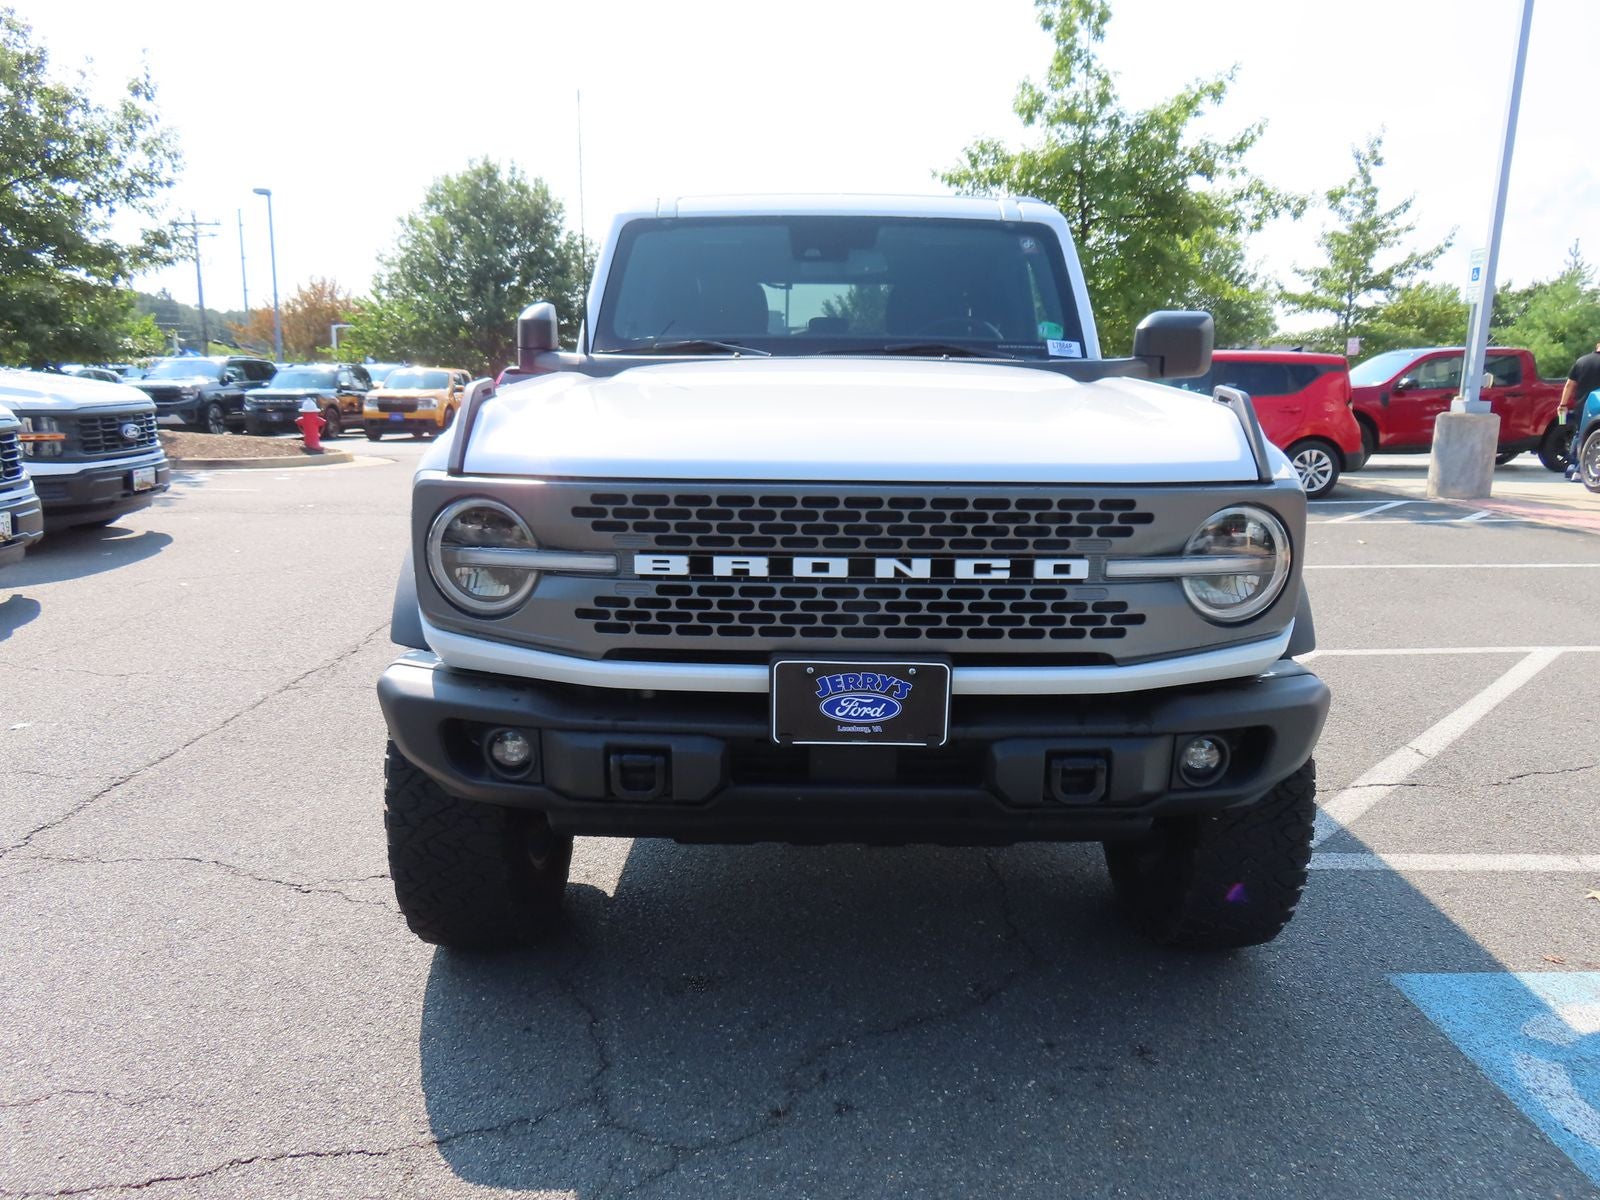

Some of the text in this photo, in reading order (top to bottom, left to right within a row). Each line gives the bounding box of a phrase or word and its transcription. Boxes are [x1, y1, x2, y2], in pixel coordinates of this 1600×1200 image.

[634, 555, 1090, 579] BRONCO
[815, 672, 913, 699] JERRY'S
[835, 697, 886, 717] Ford
